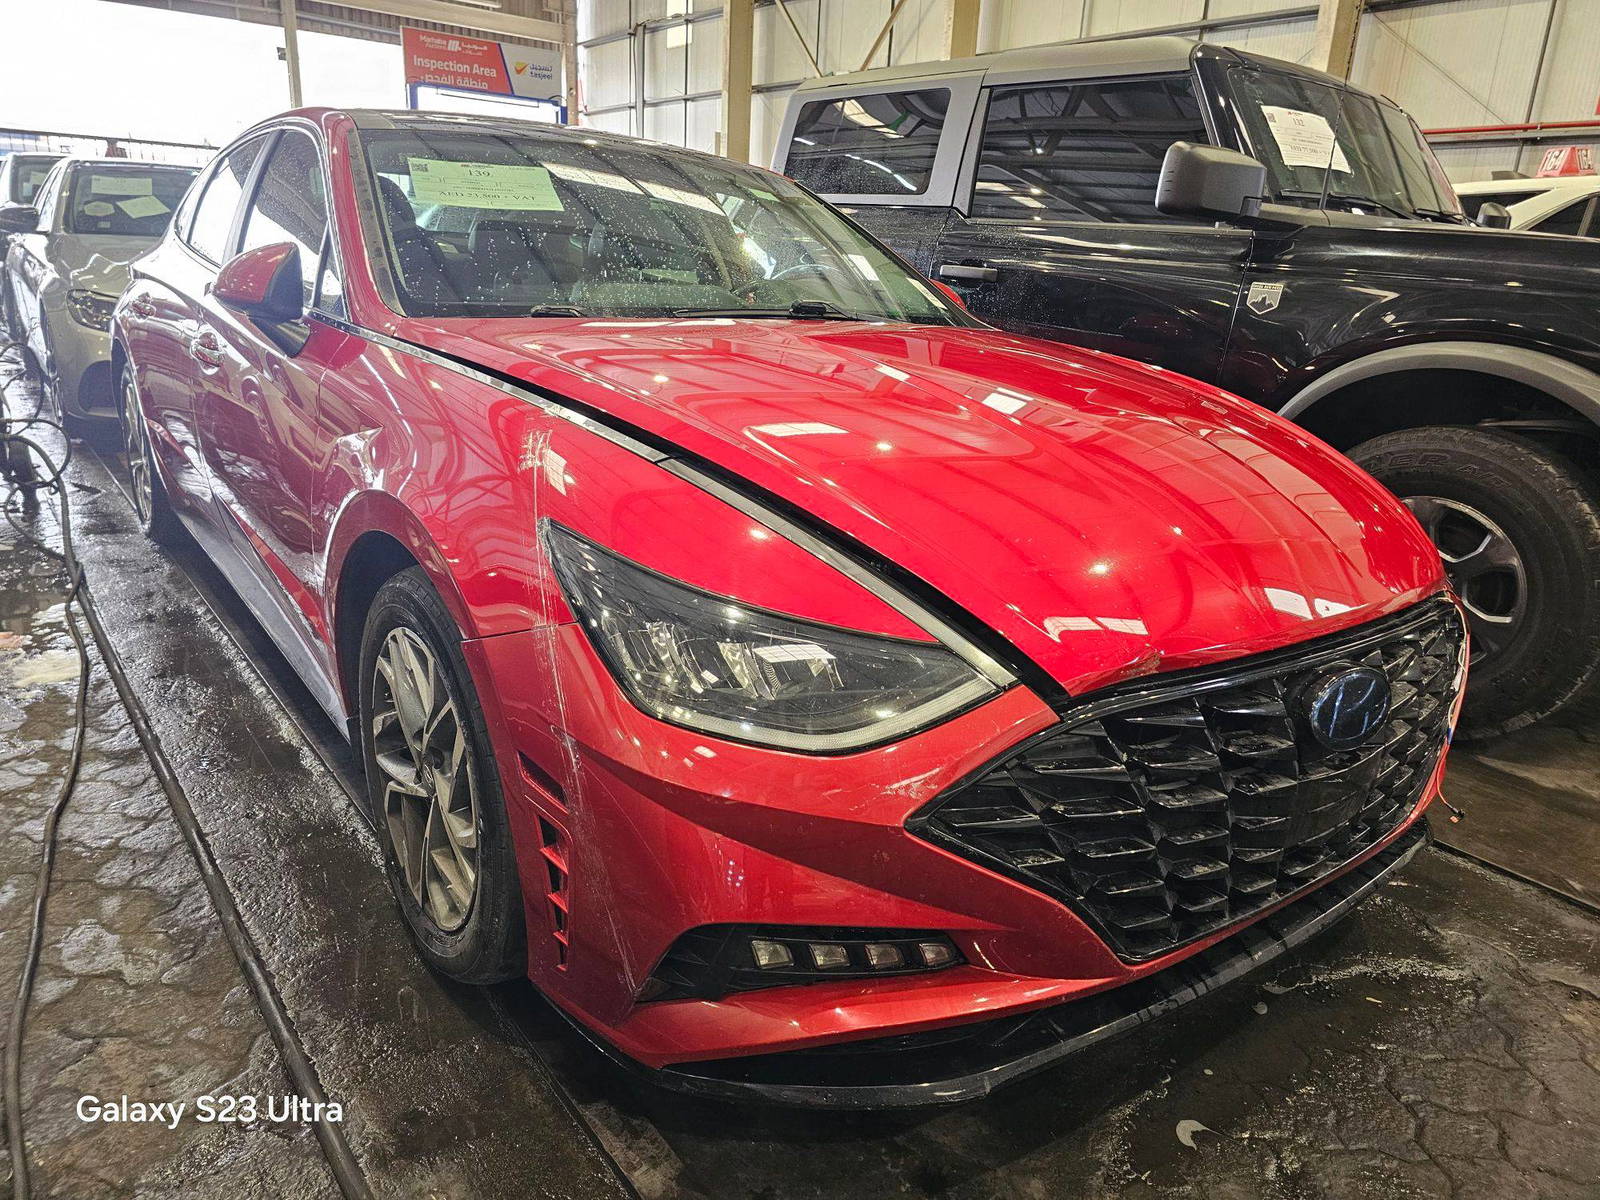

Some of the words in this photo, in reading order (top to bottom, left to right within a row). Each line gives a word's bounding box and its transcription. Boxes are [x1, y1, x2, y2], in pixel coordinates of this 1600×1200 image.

[413, 54, 470, 73] Inspection
[472, 63, 497, 78] Area
[1540, 149, 1566, 172] 164
